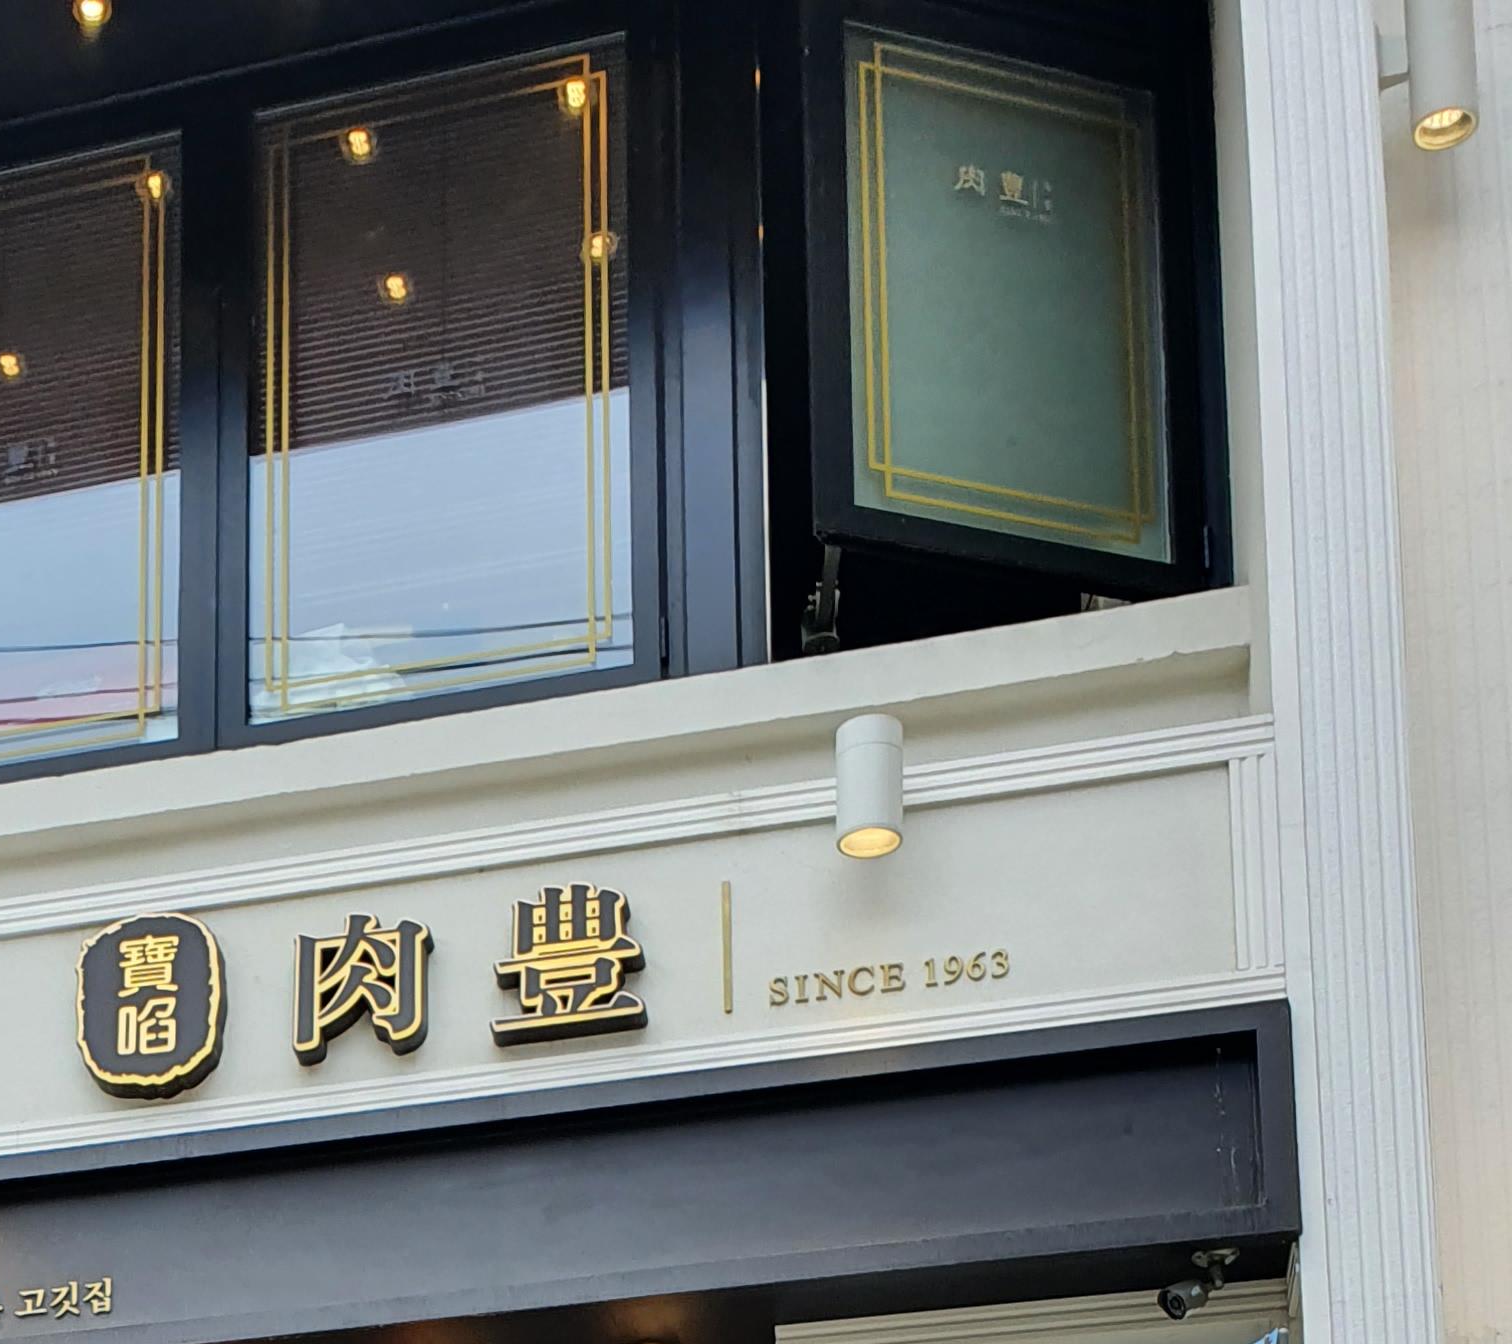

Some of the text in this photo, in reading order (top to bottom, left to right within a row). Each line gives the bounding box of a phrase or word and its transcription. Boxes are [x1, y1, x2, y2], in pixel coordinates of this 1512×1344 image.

[768, 947, 1011, 1007] SINCE 1963
[14, 1277, 114, 1319] 고깃집
